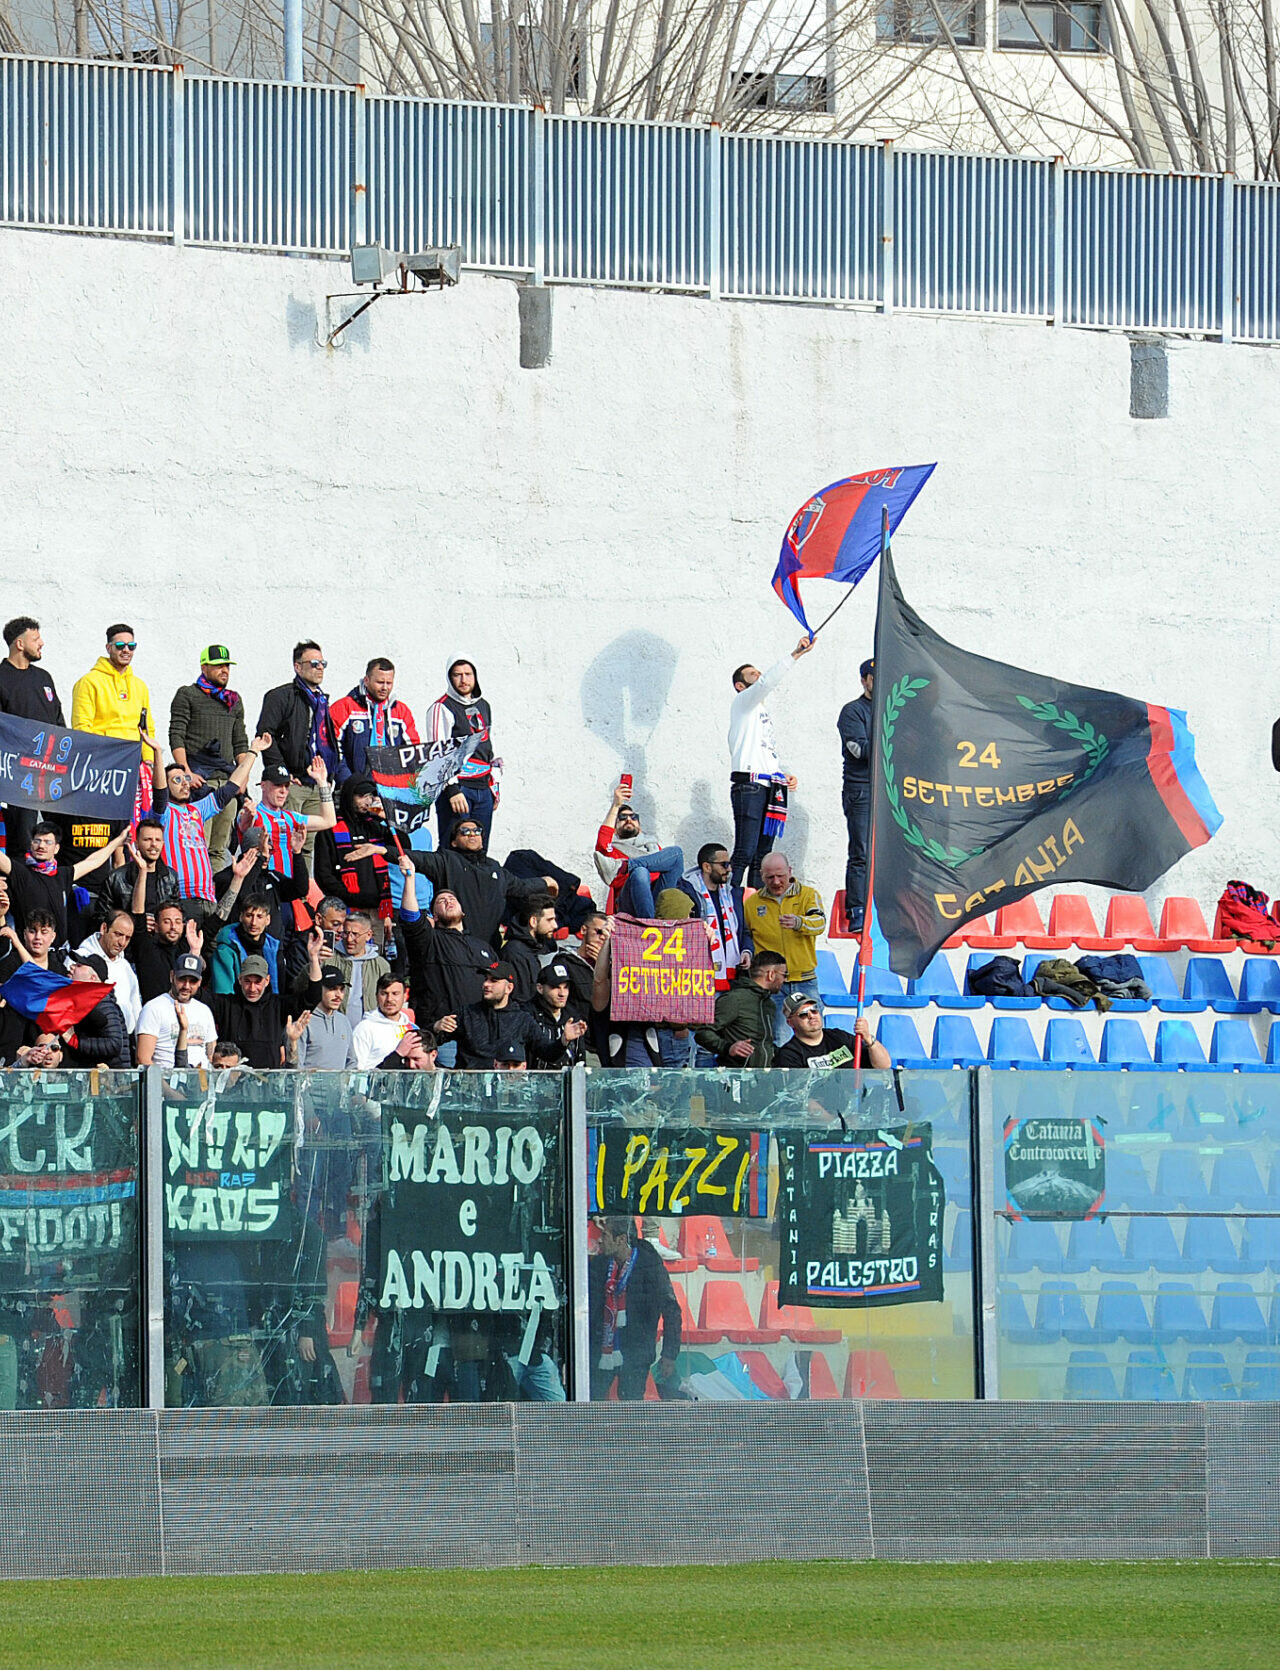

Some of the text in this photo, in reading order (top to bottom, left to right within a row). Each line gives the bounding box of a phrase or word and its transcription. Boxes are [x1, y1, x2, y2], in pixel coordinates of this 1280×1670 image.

[29, 759, 56, 772] CATANIA
[956, 741, 1001, 769] 24
[903, 773, 1074, 807] SETTEMBRE
[934, 817, 1085, 919] CATANIA
[641, 927, 687, 962] 24
[618, 966, 716, 996] SETTEMBRE
[1025, 1121, 1082, 1140] Catania
[389, 1123, 545, 1185] MARIO
[818, 1150, 898, 1179] PIAZZA
[1008, 1141, 1102, 1161] Controcorree
[596, 1134, 750, 1214] I PAZZI
[165, 1182, 280, 1232] KAOS
[459, 1199, 477, 1237] e
[786, 1146, 798, 1285] CATANIA
[379, 1249, 560, 1311] ANDREA
[807, 1256, 917, 1287] PALESTRO
